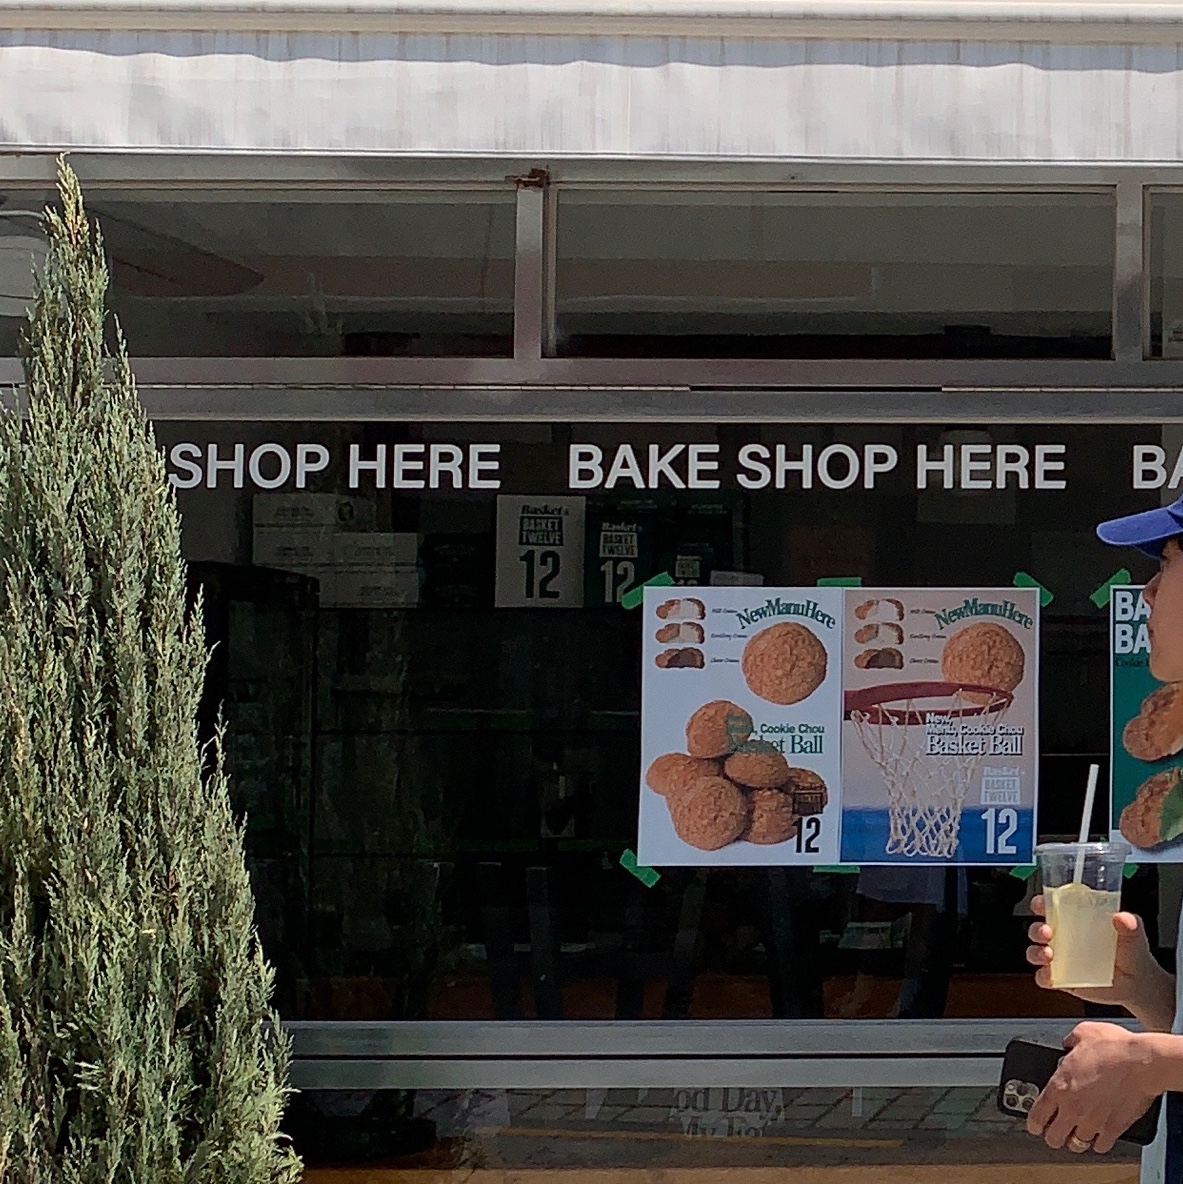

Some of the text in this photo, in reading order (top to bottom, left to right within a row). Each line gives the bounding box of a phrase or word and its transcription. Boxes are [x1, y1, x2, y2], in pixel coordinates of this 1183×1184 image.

[168, 442, 501, 489] SHOP HERE
[568, 442, 1066, 491] BAKE SHOP HERE
[522, 517, 560, 531] BASKET
[519, 549, 560, 599] 12
[600, 559, 635, 603] 12
[760, 723, 795, 734] Cookie
[798, 723, 825, 734] Chou
[790, 735, 823, 754] Ball
[926, 735, 1023, 756] Basket Ball
[960, 724, 996, 736] Cookie
[998, 723, 1024, 736] Chou
[791, 816, 821, 854] 12
[981, 807, 1018, 855] 12
